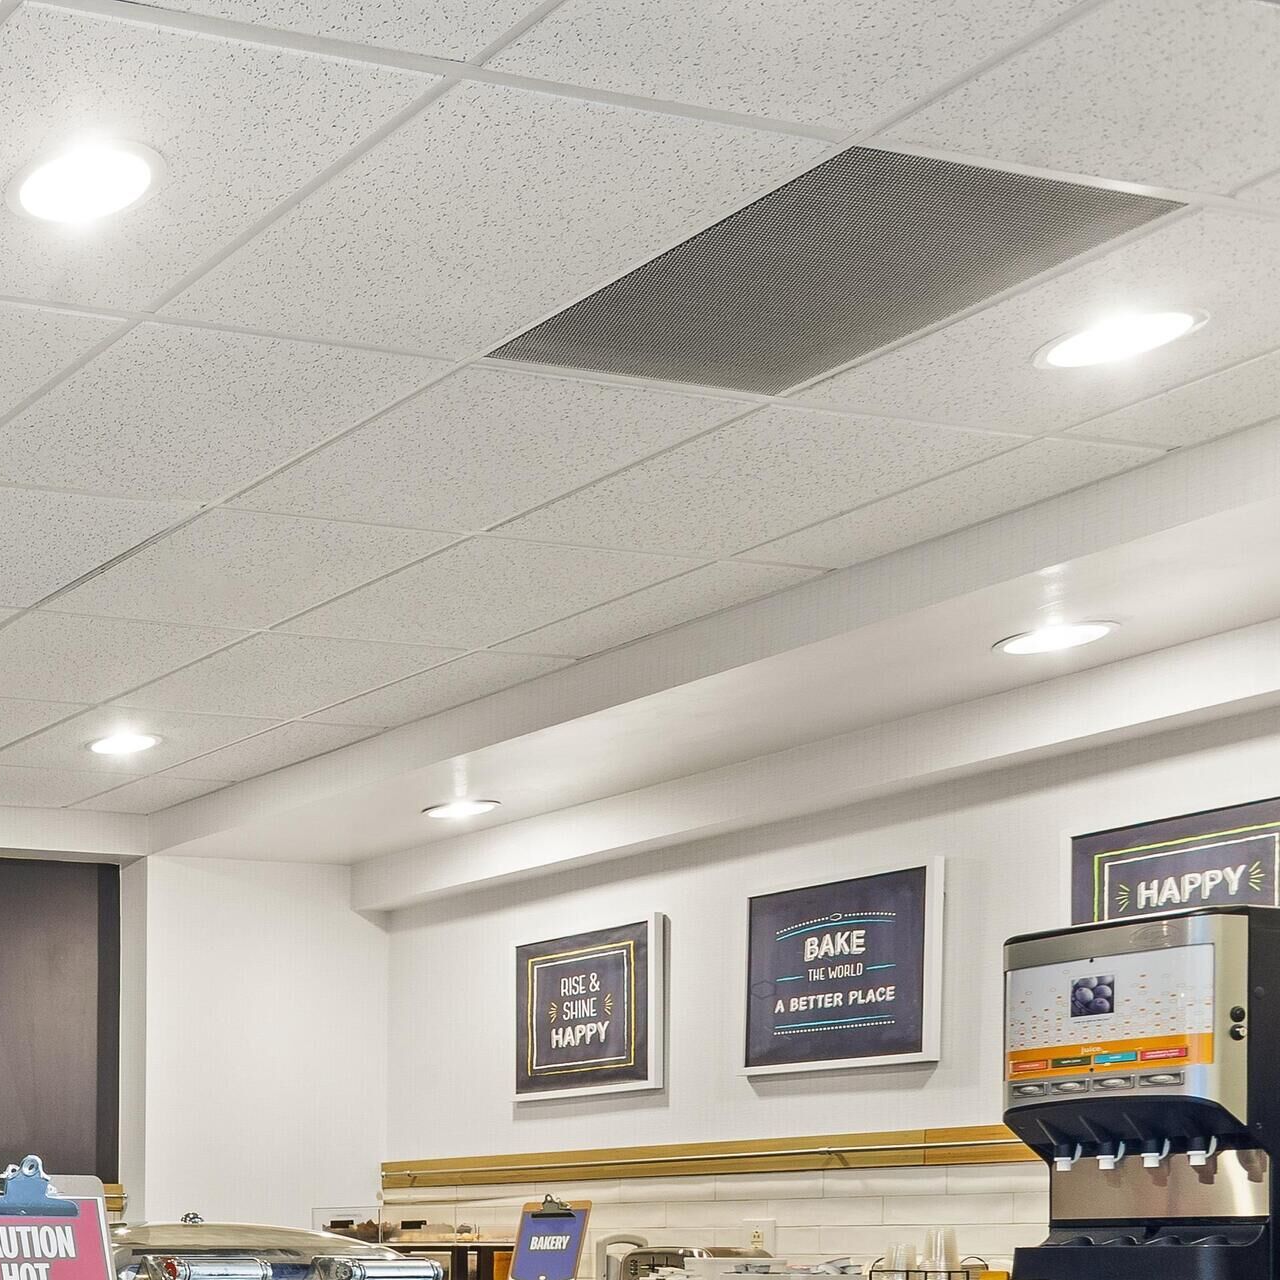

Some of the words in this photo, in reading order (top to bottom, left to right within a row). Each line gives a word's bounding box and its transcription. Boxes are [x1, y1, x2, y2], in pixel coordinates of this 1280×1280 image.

[1137, 864, 1247, 909] HAPPY
[803, 930, 866, 962] BAKE
[560, 974, 586, 997] RISE
[589, 972, 601, 992] &
[808, 967, 826, 982] THE
[827, 962, 864, 979] WORLD
[562, 997, 598, 1020] SHINE
[774, 999, 785, 1014] A
[789, 993, 843, 1012] BETTER
[848, 986, 896, 1006] PLACE
[551, 1021, 610, 1049] HAPPY
[530, 1235, 570, 1250] BAKERY
